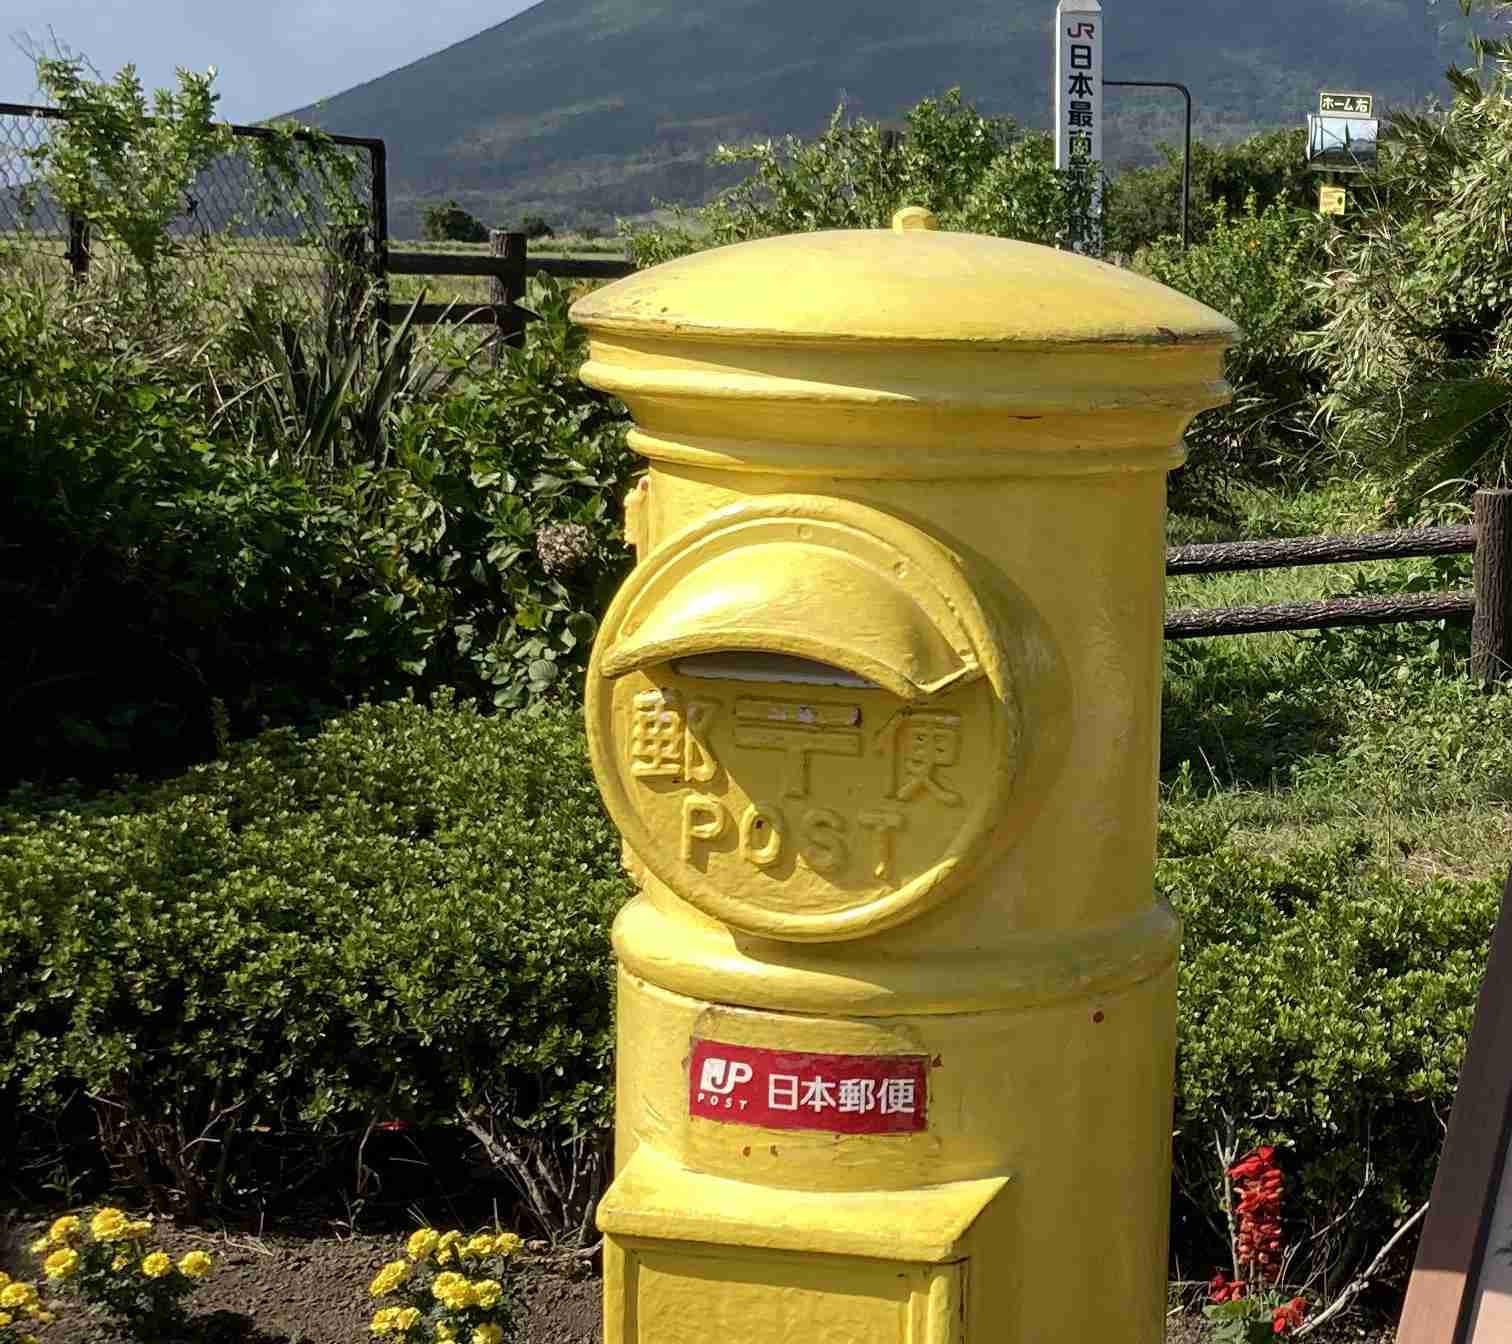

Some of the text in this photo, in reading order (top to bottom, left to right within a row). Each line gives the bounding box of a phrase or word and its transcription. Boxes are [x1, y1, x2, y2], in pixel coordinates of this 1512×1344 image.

[682, 793, 908, 879] POST
[697, 1093, 748, 1110] POST
[768, 1074, 916, 1114] 日本郵便
